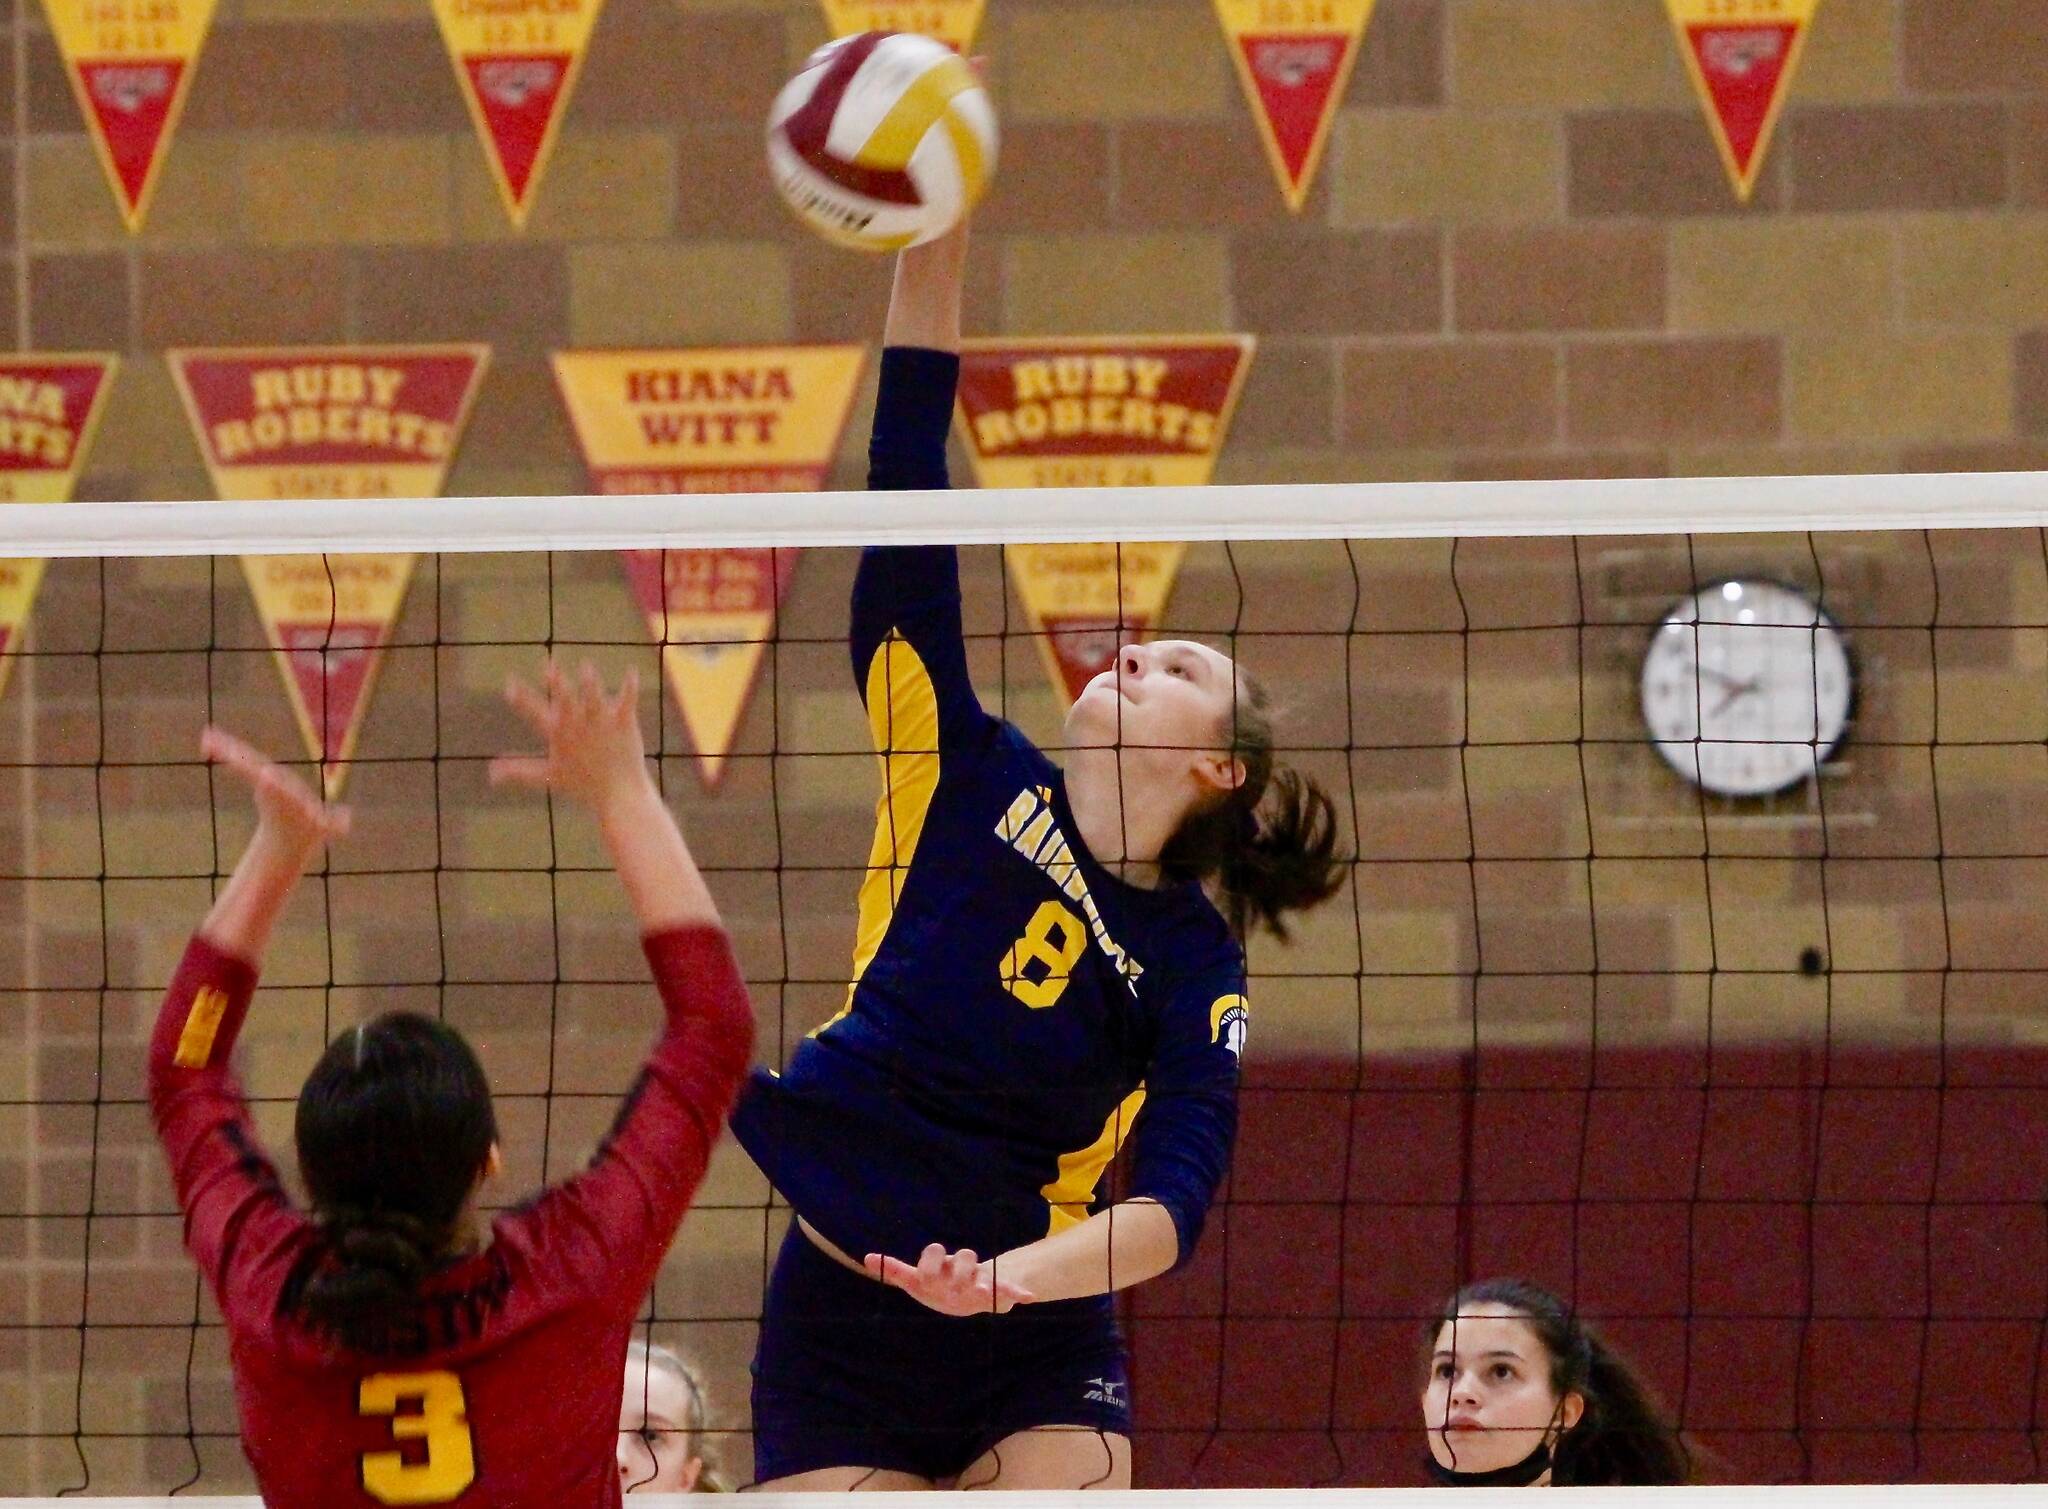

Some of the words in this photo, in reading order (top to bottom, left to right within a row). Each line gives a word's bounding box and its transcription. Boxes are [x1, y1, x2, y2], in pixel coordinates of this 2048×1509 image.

[253, 363, 406, 408] RUBY
[625, 366, 797, 402] KIANA
[1012, 355, 1168, 402] RUBY
[213, 406, 453, 461] ROBERTS
[637, 410, 779, 445] WITT
[975, 397, 1217, 451] ROBERTS
[999, 900, 1088, 1010] 8
[358, 1369, 476, 1505] 3
